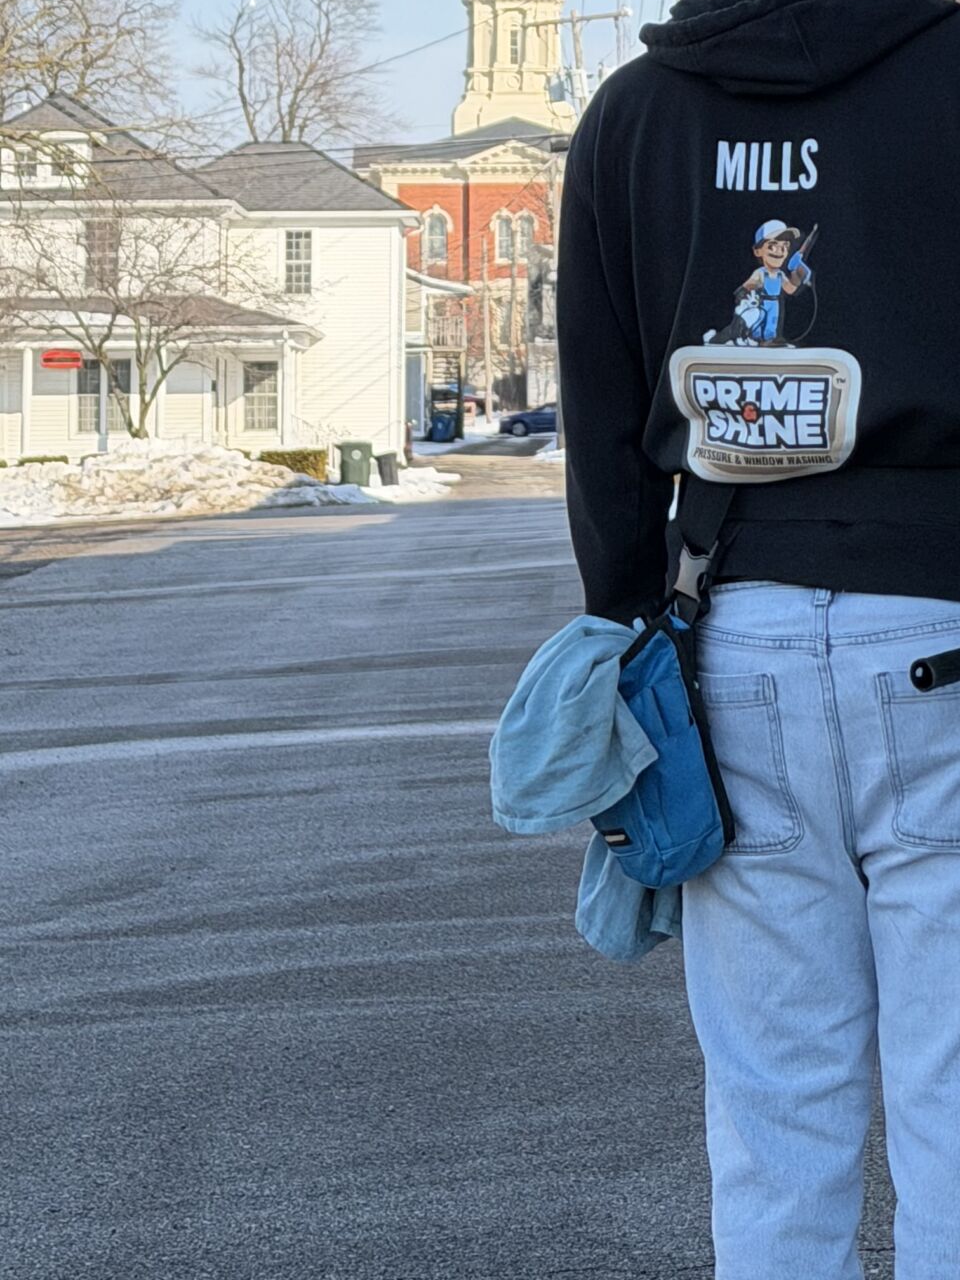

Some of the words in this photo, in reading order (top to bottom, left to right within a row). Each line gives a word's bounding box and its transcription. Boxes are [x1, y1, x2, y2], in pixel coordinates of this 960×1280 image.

[716, 138, 818, 190] MILLS
[695, 379, 824, 411] PRIME
[708, 410, 823, 446] SHINE
[744, 405, 757, 421] &
[694, 447, 732, 463] PRESSURE
[744, 456, 784, 465] WINDOW
[787, 455, 833, 465] WASHING
